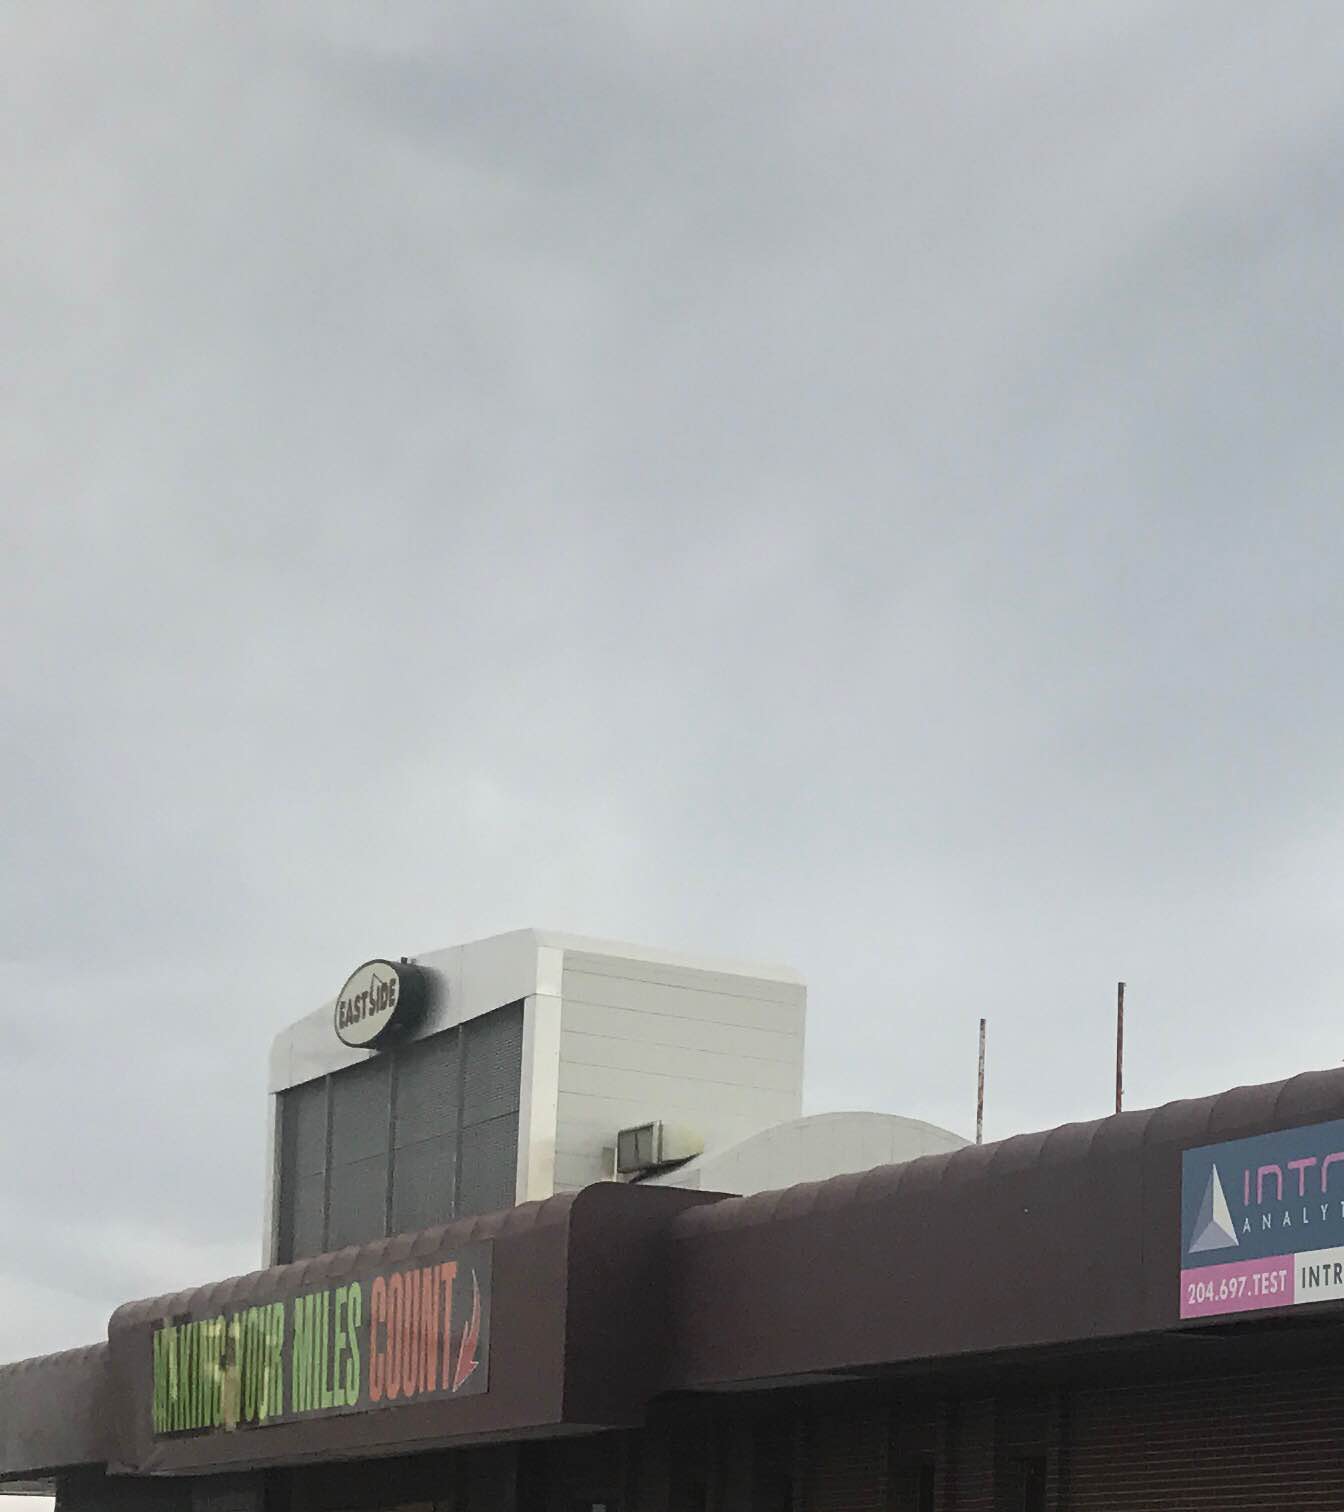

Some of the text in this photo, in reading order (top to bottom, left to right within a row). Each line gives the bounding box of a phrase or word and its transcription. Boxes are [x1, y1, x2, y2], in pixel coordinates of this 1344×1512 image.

[1187, 1269, 1288, 1306] 204.697.TEST
[292, 1281, 362, 1413] MILES
[369, 1260, 458, 1402] COUNT
